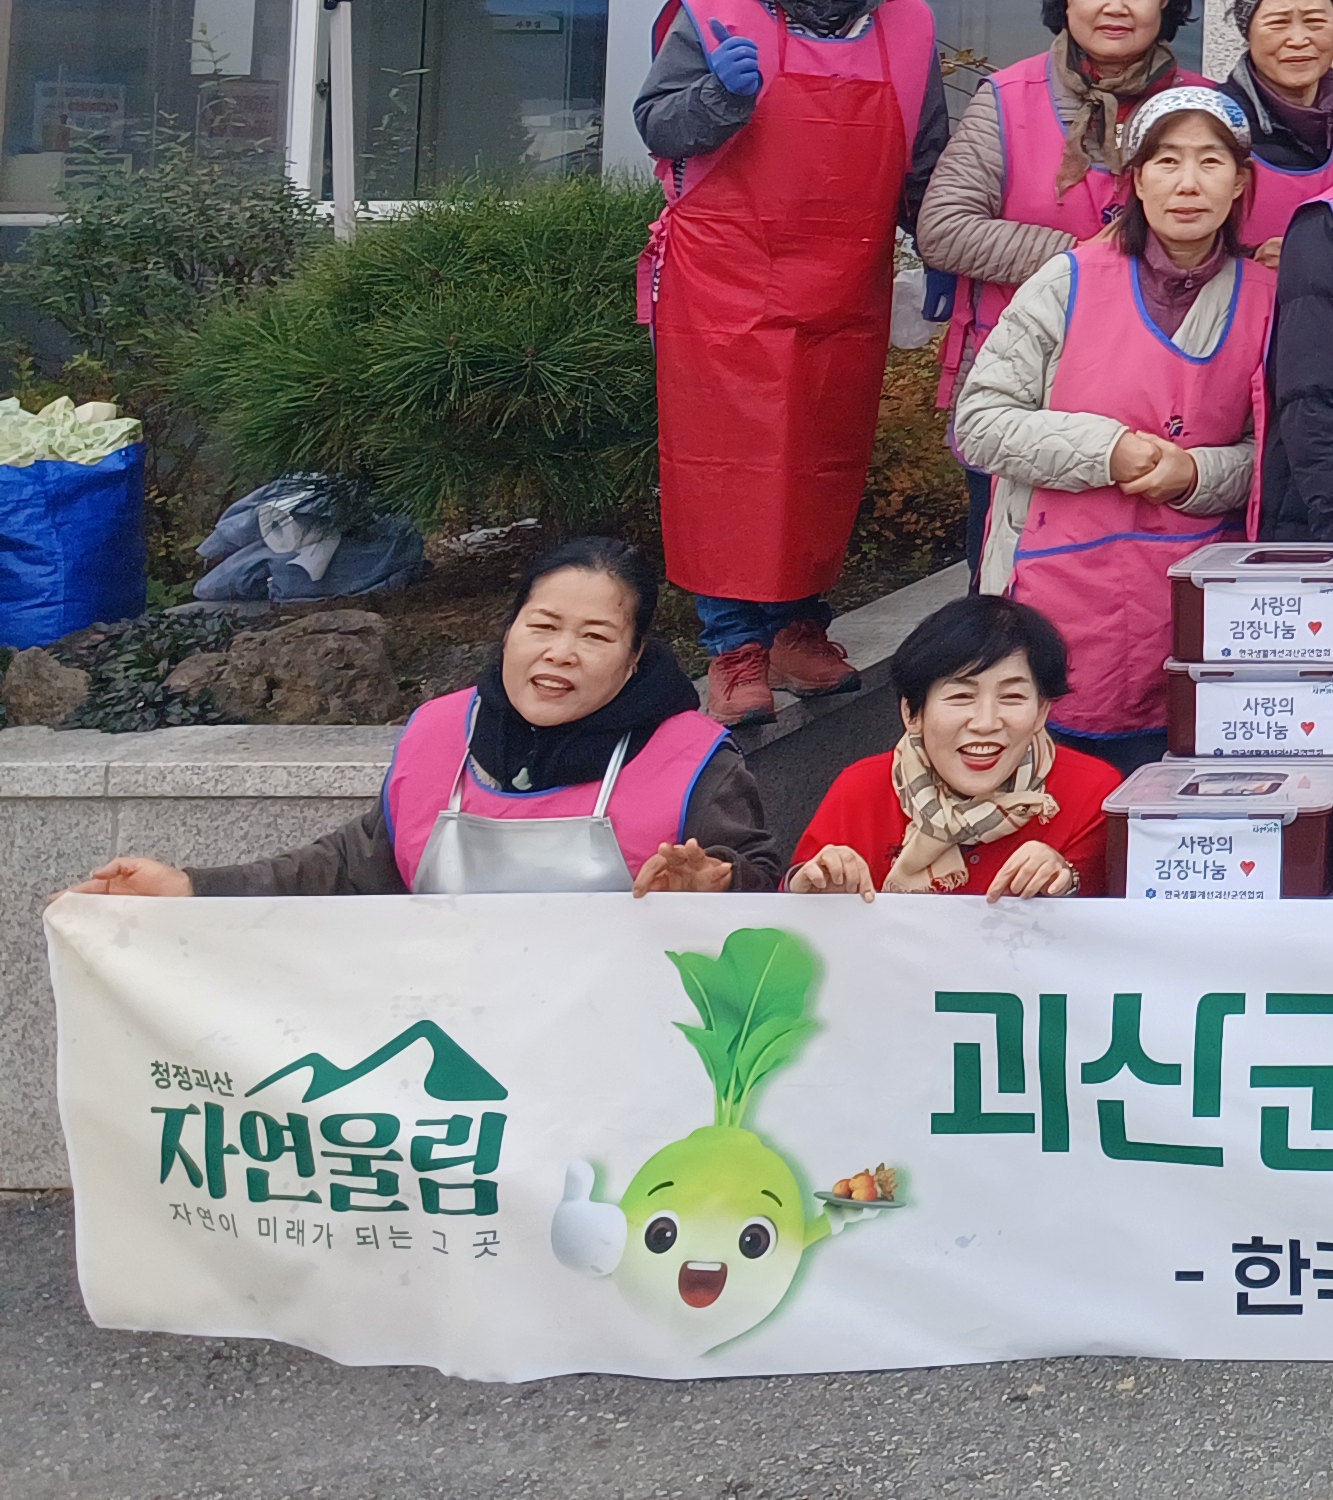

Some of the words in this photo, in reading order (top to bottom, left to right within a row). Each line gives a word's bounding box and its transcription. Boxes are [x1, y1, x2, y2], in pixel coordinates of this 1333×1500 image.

[1250, 596, 1302, 617] 사랑의
[1229, 620, 1297, 641] 김장나눔
[1242, 696, 1294, 717] 사랑의
[1221, 720, 1289, 741] 김장나눔
[1177, 835, 1233, 856] 사랑의
[1154, 859, 1228, 881] 김장나눔
[149, 1059, 235, 1098] 청정괴산
[149, 1101, 510, 1218] 자연울림
[170, 1200, 242, 1241] 자연이
[255, 1214, 337, 1251] 미래가
[354, 1219, 414, 1252] 되는
[430, 1229, 451, 1255] 그
[470, 1228, 504, 1260] 곳
